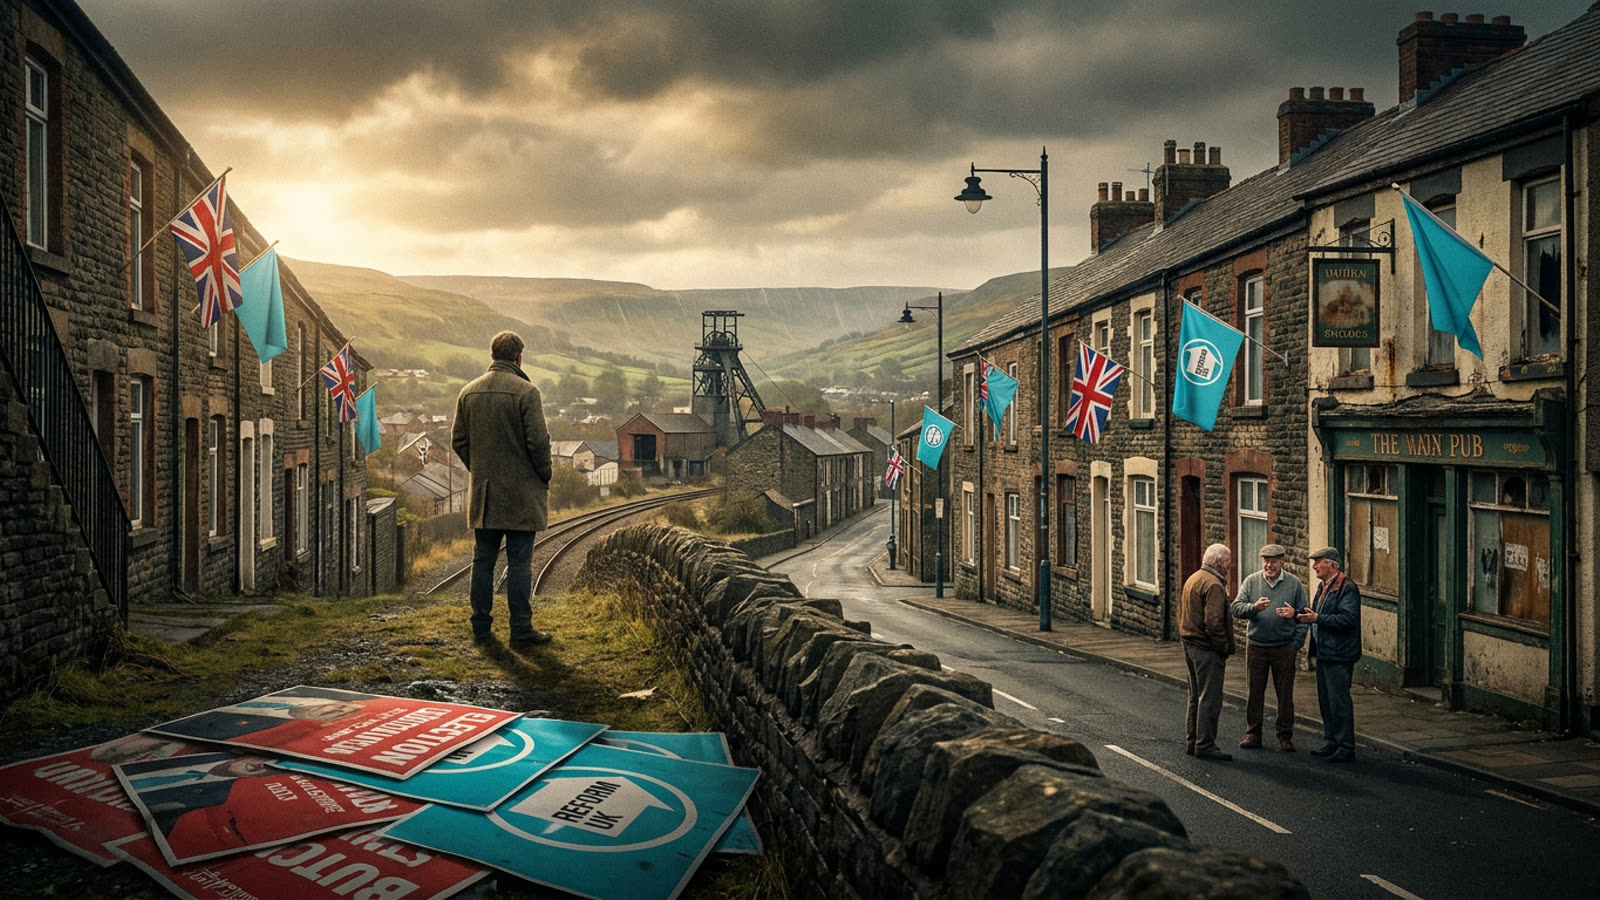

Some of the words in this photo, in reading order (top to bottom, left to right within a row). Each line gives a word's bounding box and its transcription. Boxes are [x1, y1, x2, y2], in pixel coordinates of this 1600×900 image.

[1370, 433, 1400, 456] THE
[1450, 434, 1484, 459] PUB
[370, 712, 498, 767] ELECTION
[551, 780, 622, 823] REFORM
[583, 810, 624, 831] UK
[255, 842, 422, 900] BUTC
